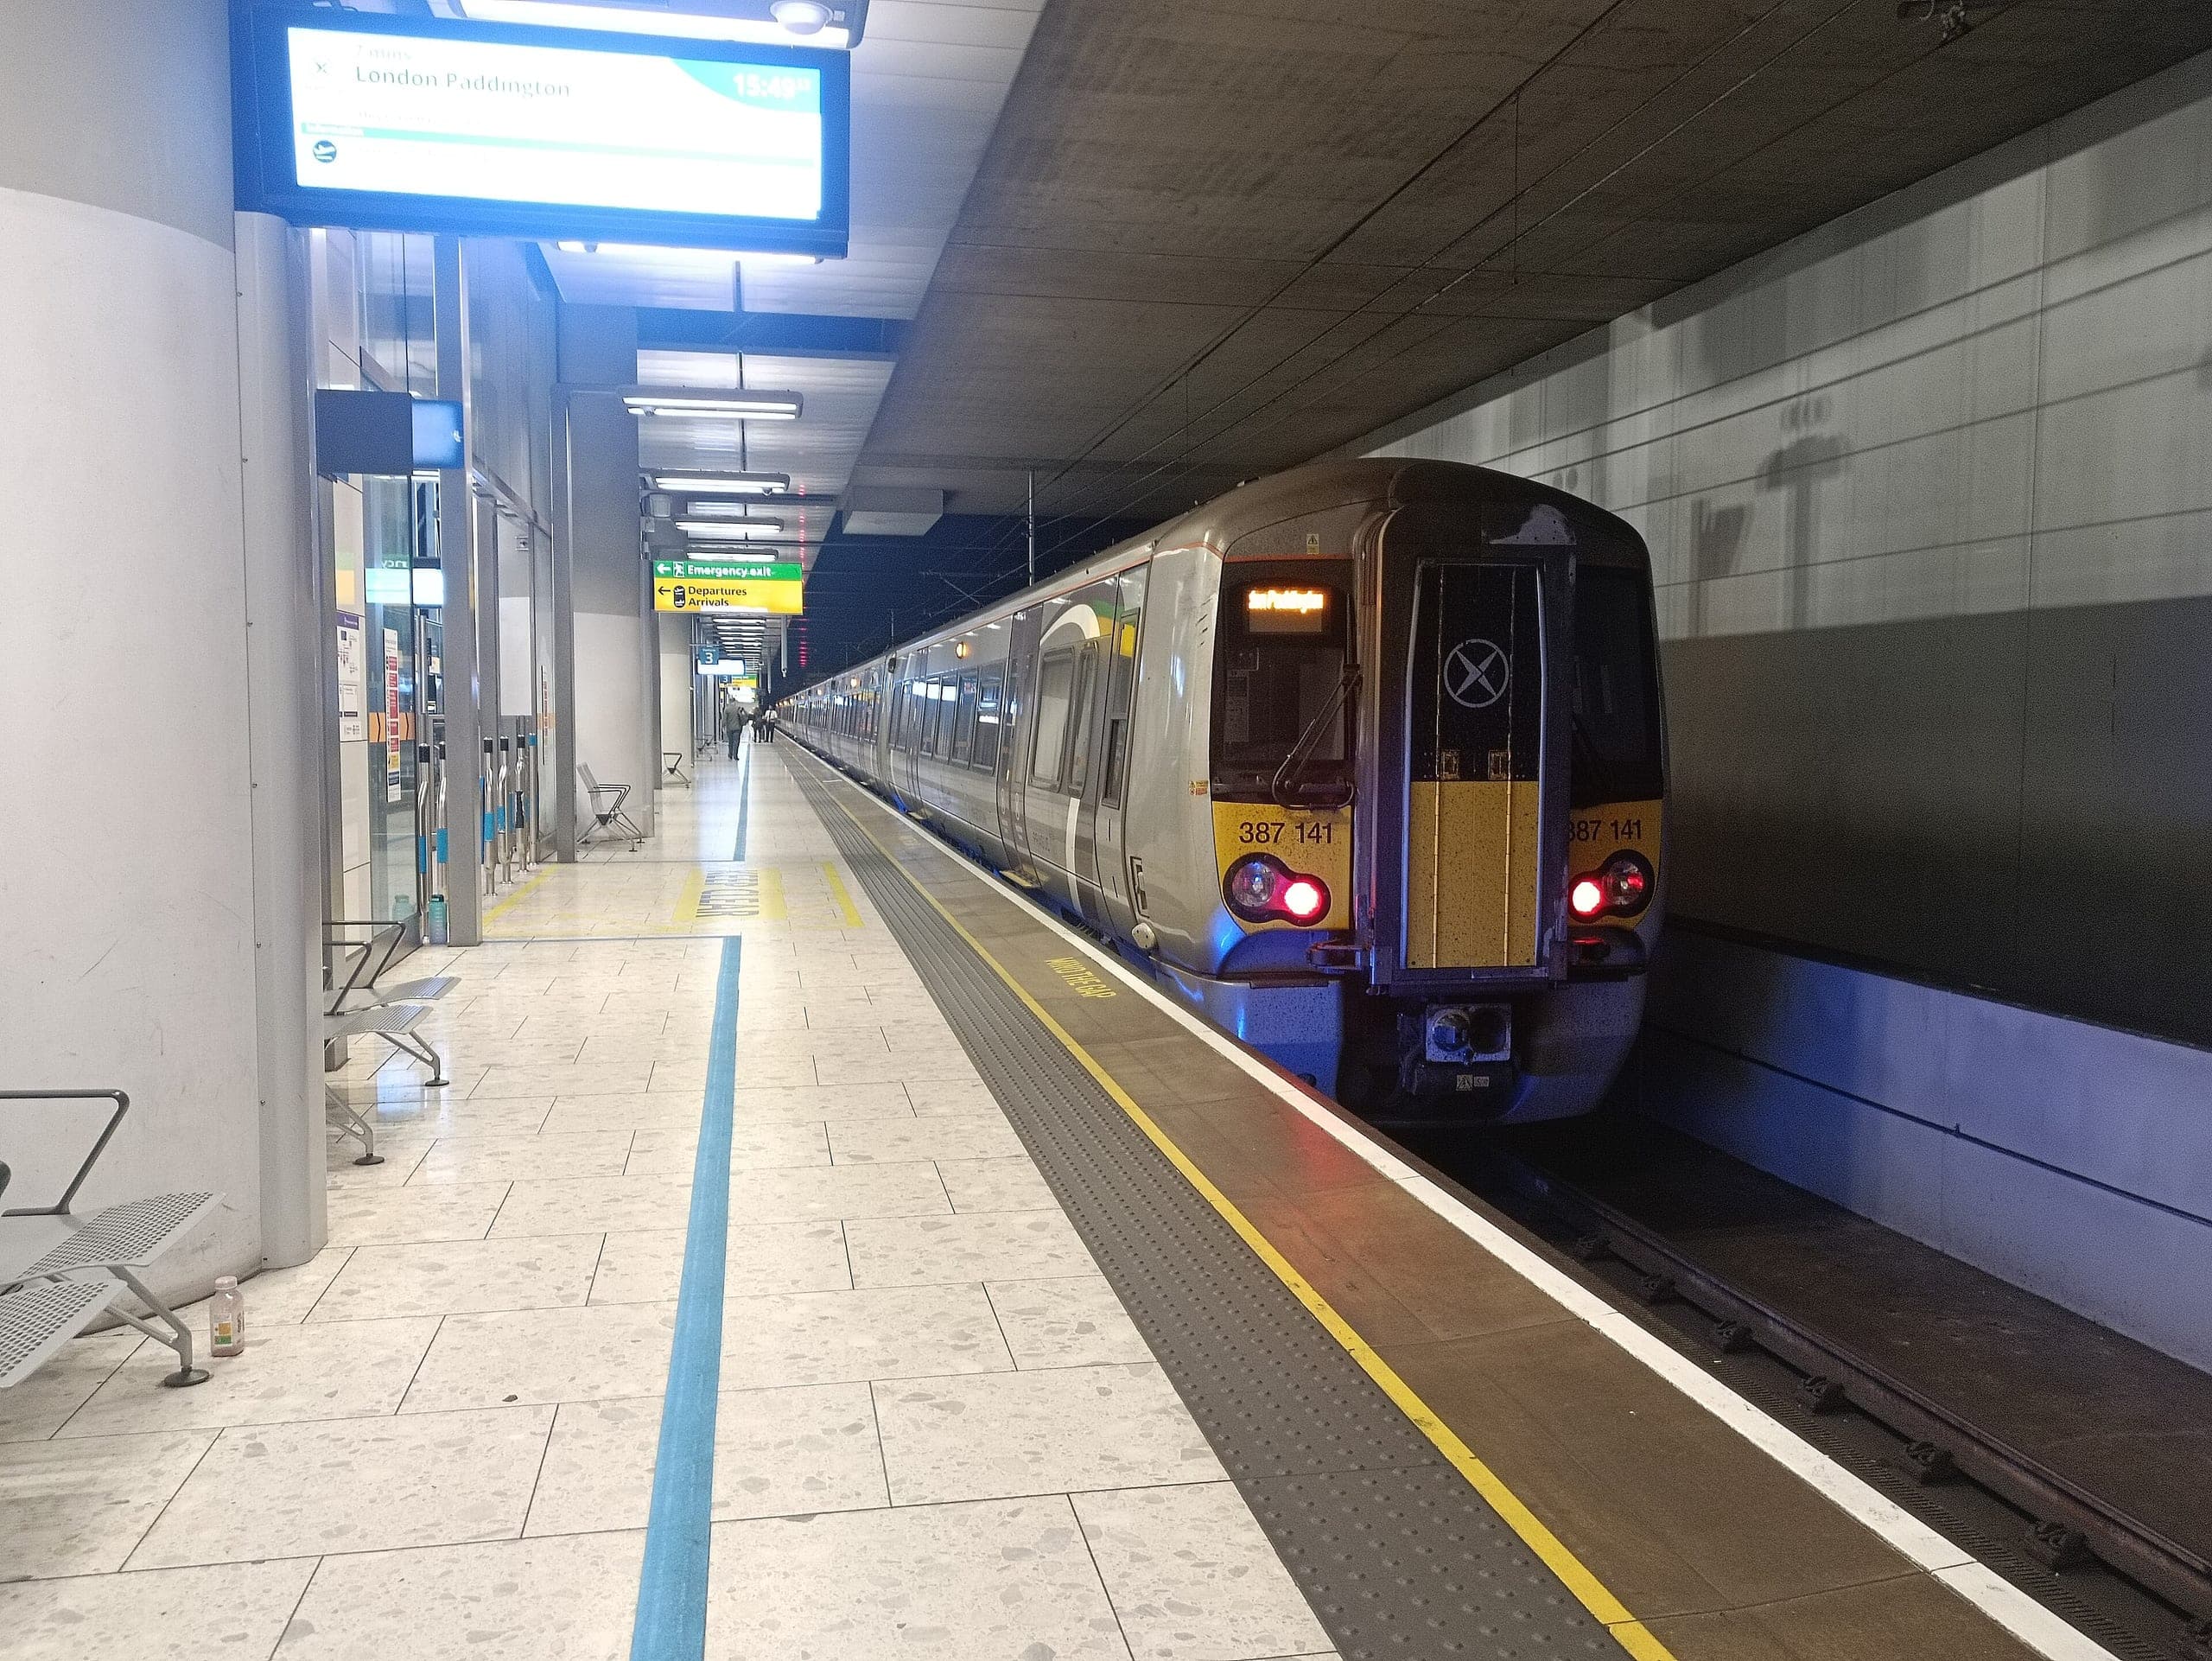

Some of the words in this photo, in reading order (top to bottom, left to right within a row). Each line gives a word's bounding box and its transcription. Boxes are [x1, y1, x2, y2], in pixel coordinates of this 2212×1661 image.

[356, 66, 437, 86] London
[447, 72, 571, 98] Paddington
[687, 564, 748, 578] Emergency
[749, 566, 772, 577] exit
[688, 586, 747, 597] Departures
[688, 597, 729, 607] Arrivals
[705, 652, 714, 665] 3
[1238, 821, 1286, 844] 387
[1294, 822, 1332, 844] 141
[1610, 818, 1642, 841] 141
[695, 888, 760, 918] CLEAR
[1061, 971, 1102, 986] THE
[1075, 983, 1117, 998] GAP
